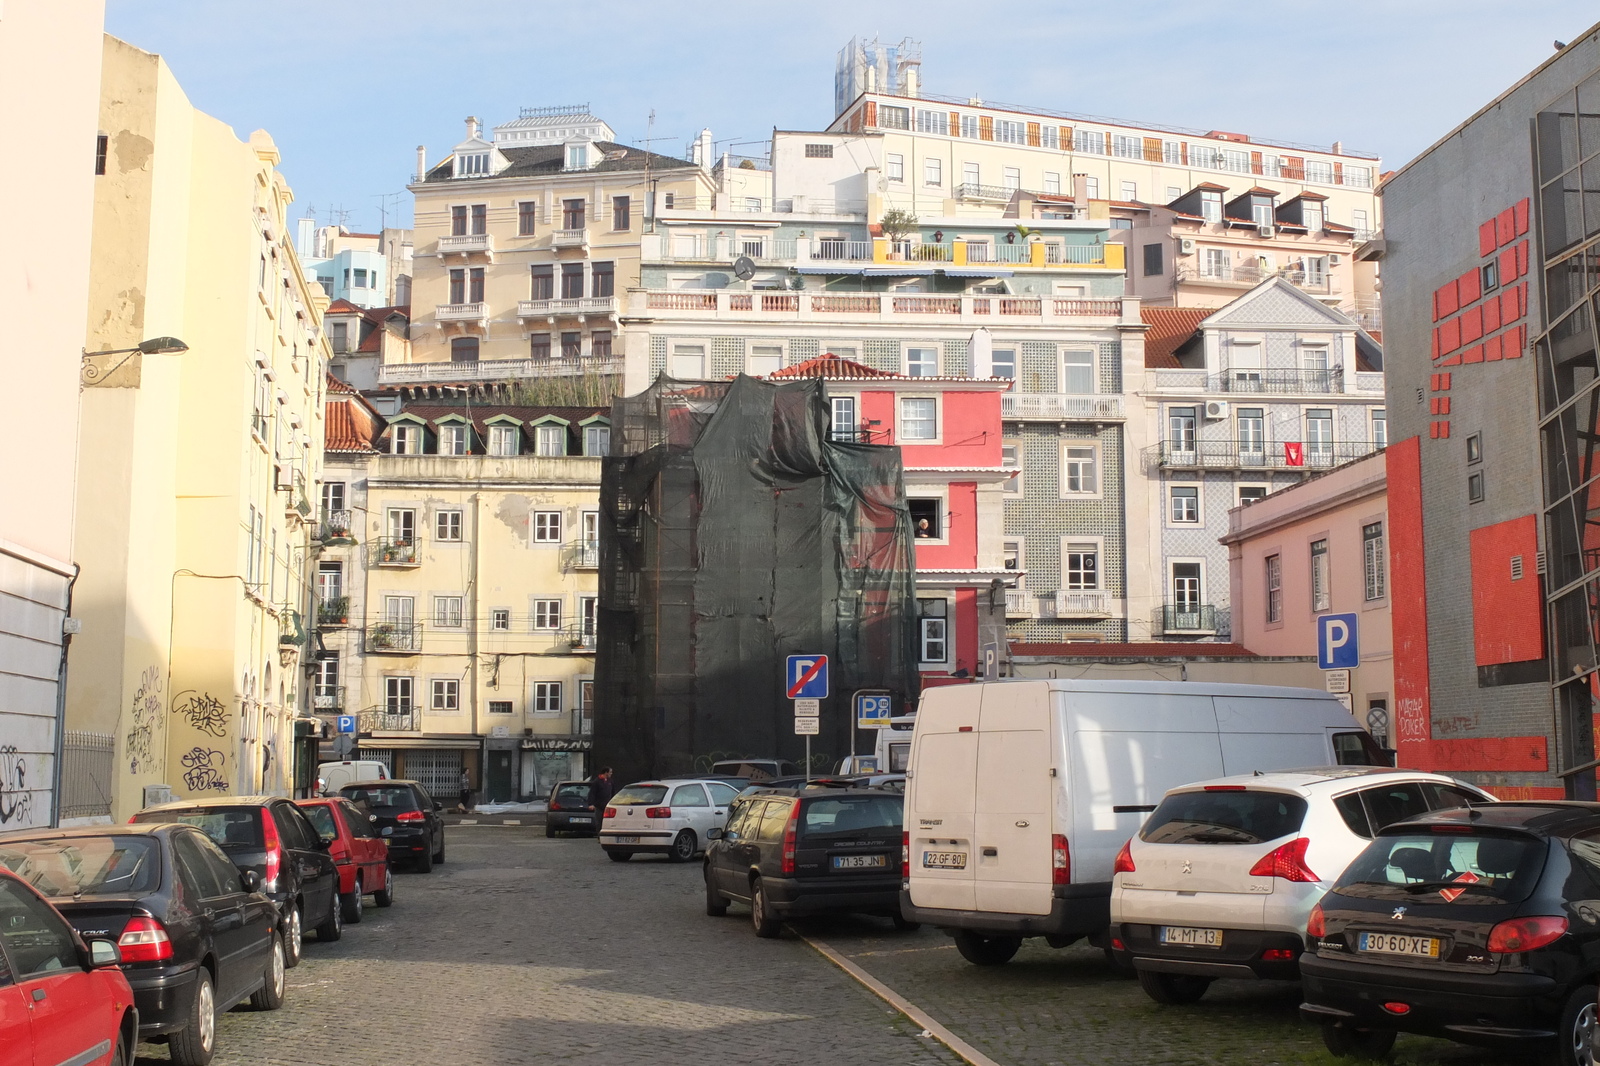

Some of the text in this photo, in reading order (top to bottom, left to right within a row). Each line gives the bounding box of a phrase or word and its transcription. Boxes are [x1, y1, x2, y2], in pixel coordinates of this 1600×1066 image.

[1326, 619, 1349, 664] P
[986, 649, 994, 676] P
[795, 659, 818, 694] P
[862, 698, 877, 719] P
[340, 717, 351, 731] P
[1317, 941, 1343, 950] PEUGEOT
[1466, 954, 1484, 962] 206
